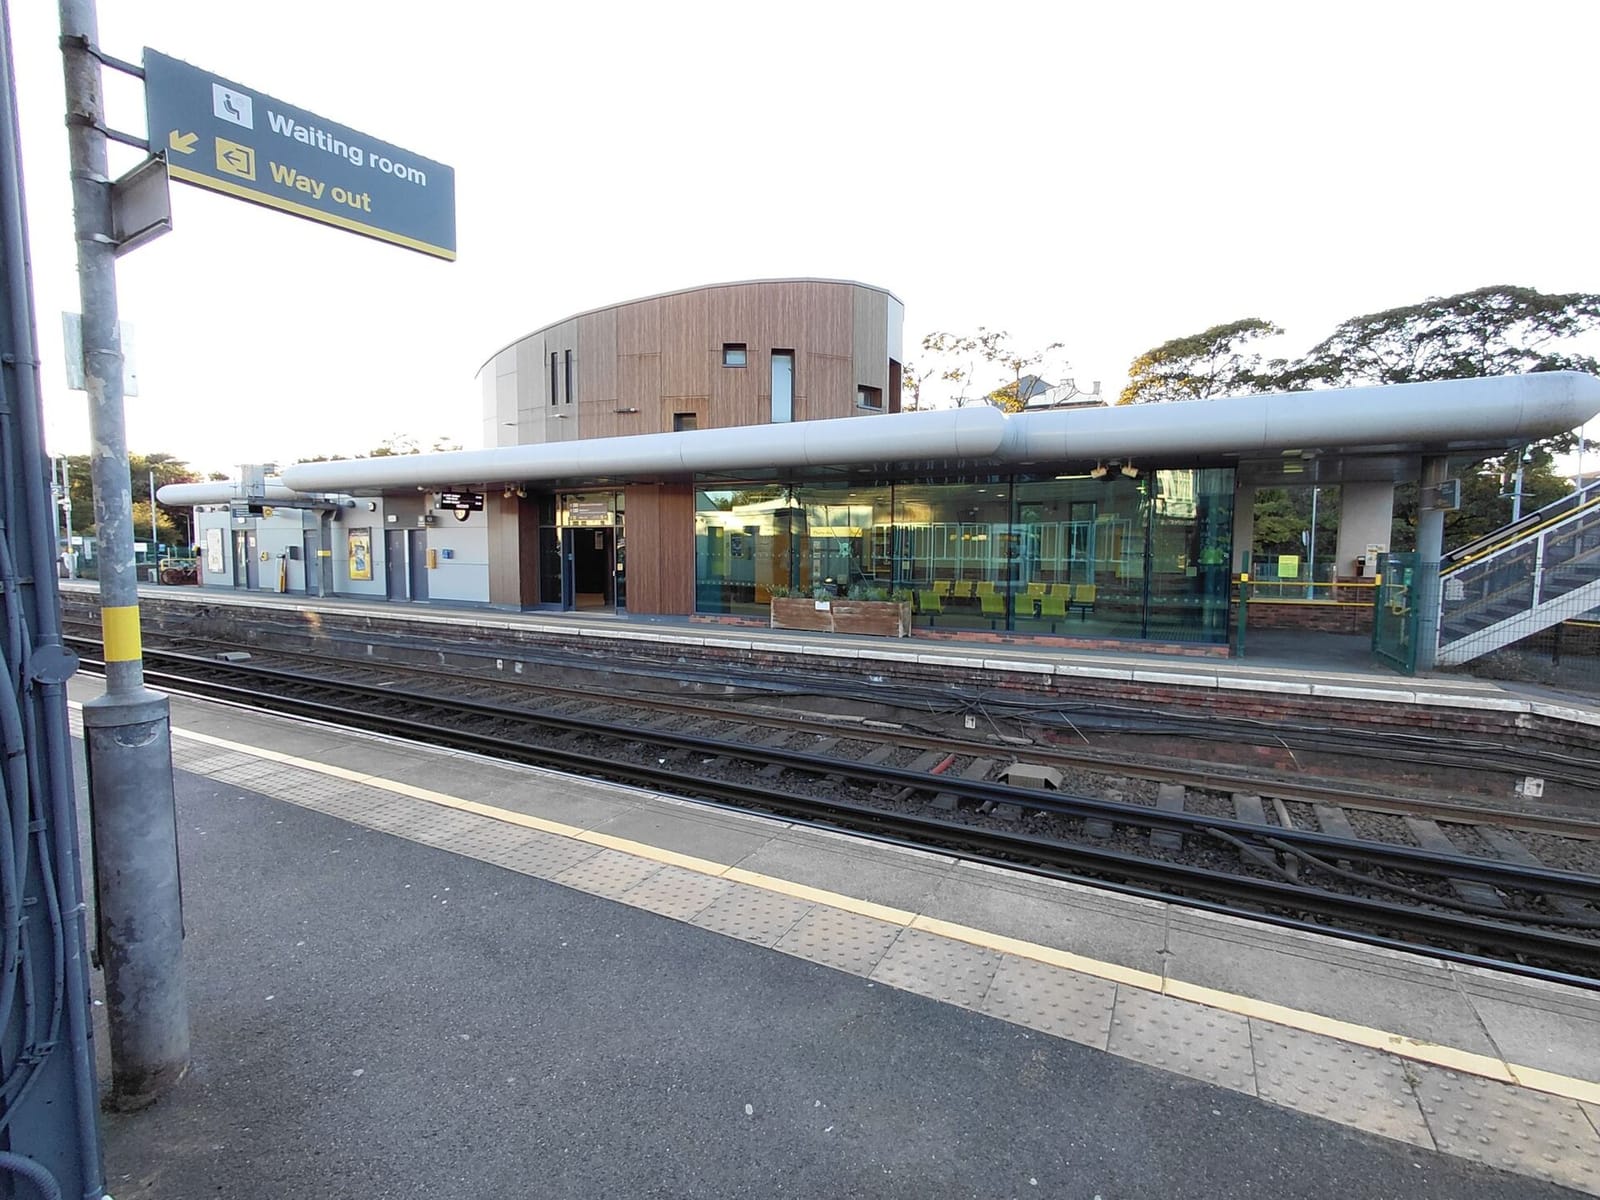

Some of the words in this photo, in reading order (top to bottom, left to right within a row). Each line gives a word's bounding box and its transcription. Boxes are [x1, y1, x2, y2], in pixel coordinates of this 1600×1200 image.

[267, 110, 363, 166] Waiting
[370, 153, 427, 187] room
[269, 161, 325, 200] Way
[331, 186, 372, 212] out
